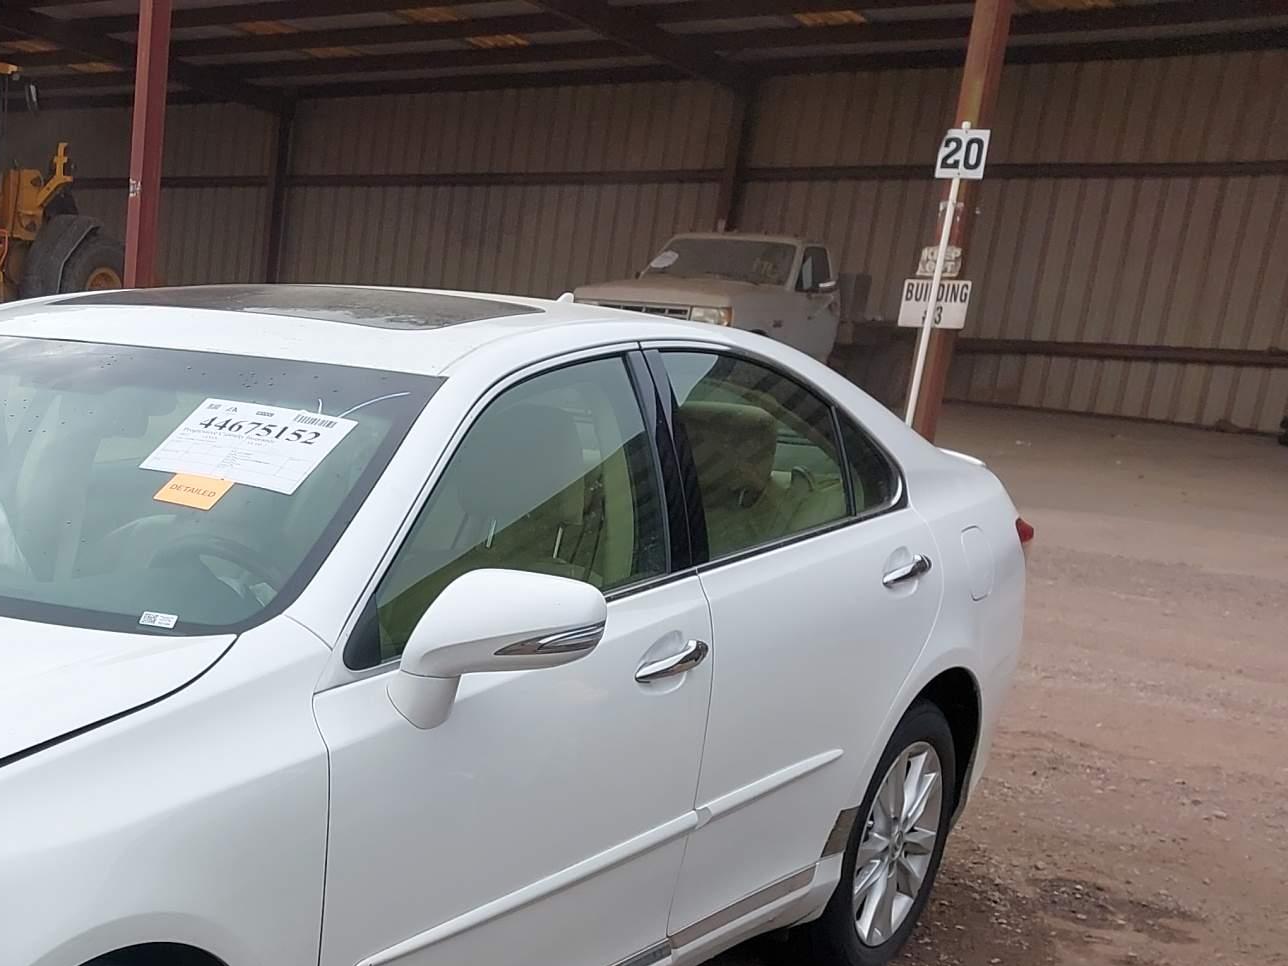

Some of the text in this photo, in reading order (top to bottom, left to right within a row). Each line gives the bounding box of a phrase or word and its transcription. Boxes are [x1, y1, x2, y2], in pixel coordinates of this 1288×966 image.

[939, 137, 985, 170] 20
[200, 416, 321, 445] 44675152
[169, 483, 217, 498] DETAILED
